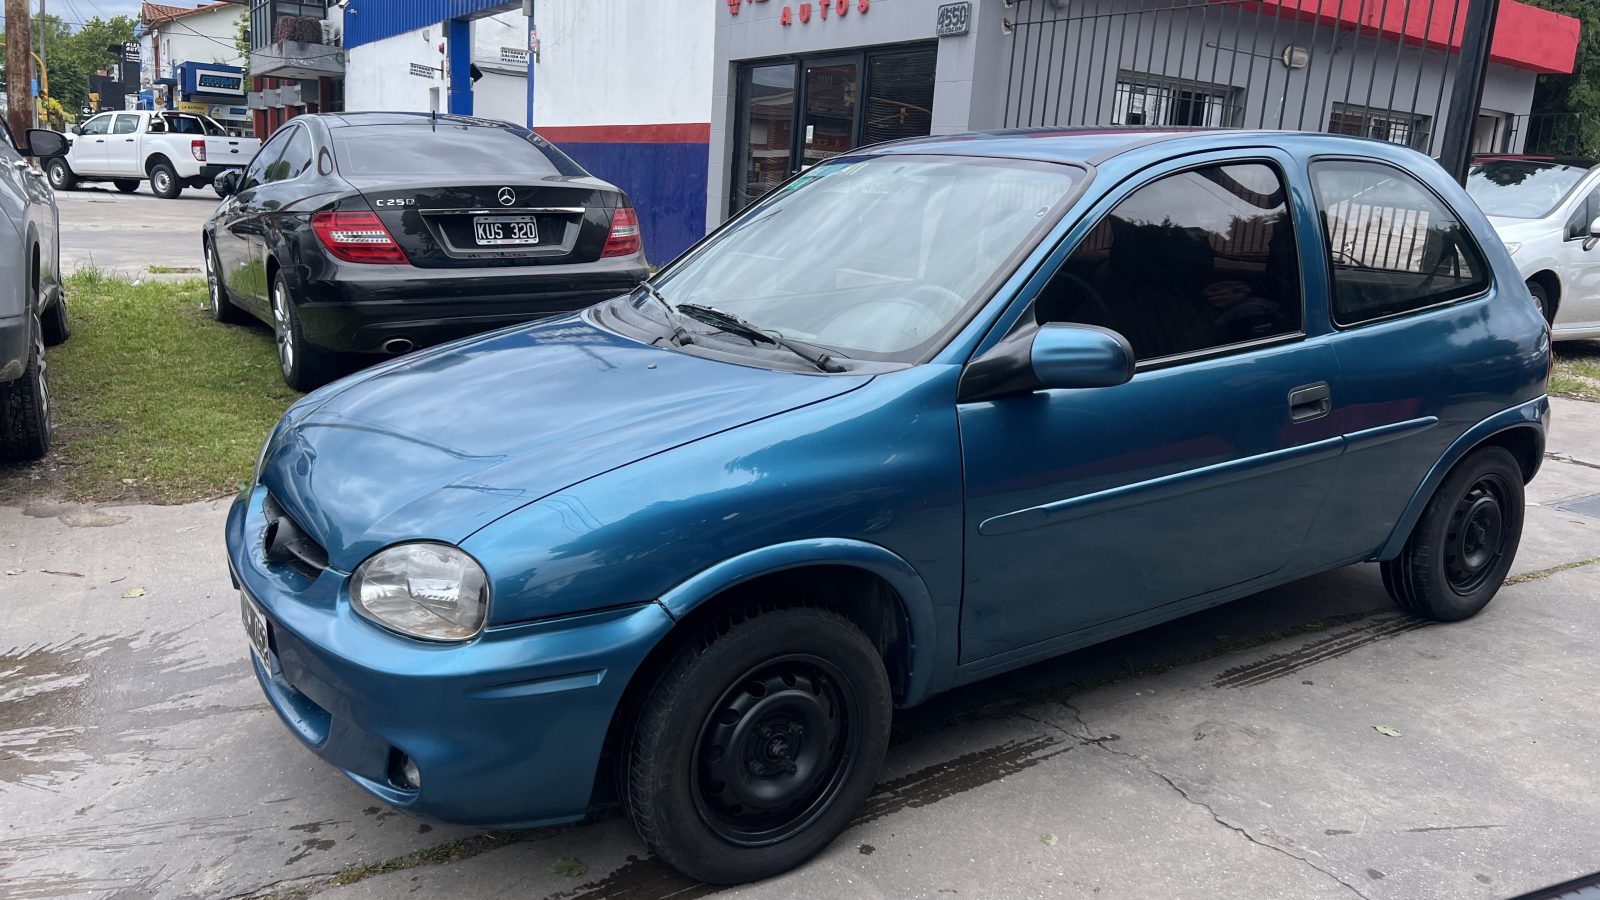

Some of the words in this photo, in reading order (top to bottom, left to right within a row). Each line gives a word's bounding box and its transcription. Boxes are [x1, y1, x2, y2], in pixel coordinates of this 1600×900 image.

[780, 0, 869, 25] AUTOS
[939, 5, 966, 27] 4550
[202, 76, 238, 86] GERBAT
[376, 199, 384, 207] C
[386, 198, 415, 206] 250
[477, 223, 503, 239] KUS
[510, 223, 536, 239] 320
